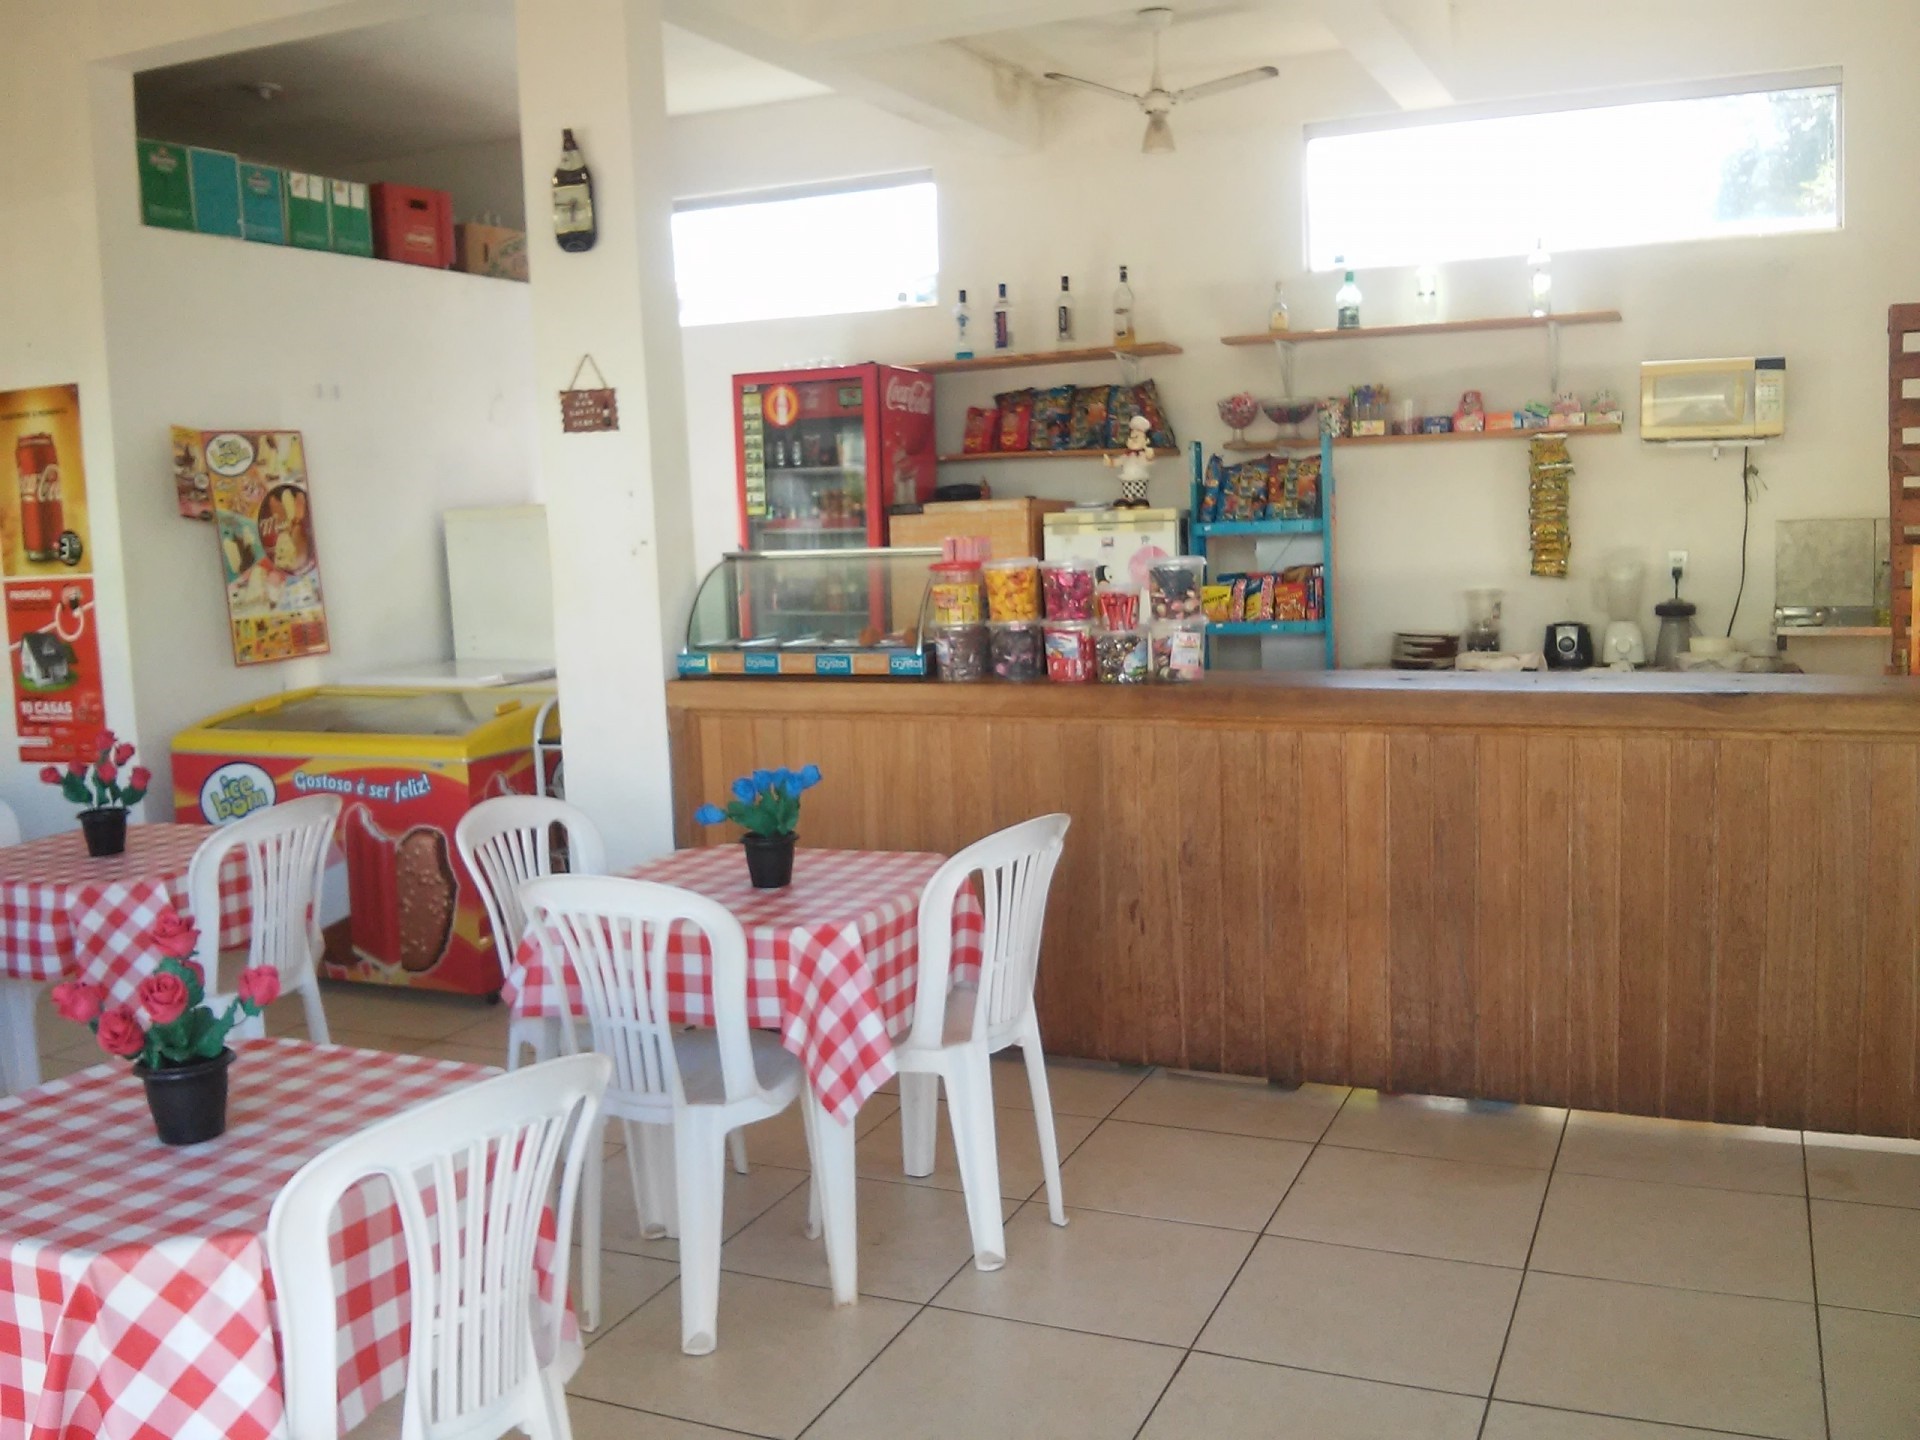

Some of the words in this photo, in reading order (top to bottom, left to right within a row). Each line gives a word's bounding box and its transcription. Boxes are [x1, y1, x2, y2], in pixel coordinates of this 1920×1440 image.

[817, 657, 848, 670] crystal
[890, 657, 922, 670] crystal
[294, 771, 353, 793] Gostoso
[356, 777, 366, 795] é
[368, 784, 391, 799] ser
[394, 772, 431, 803] feliz!
